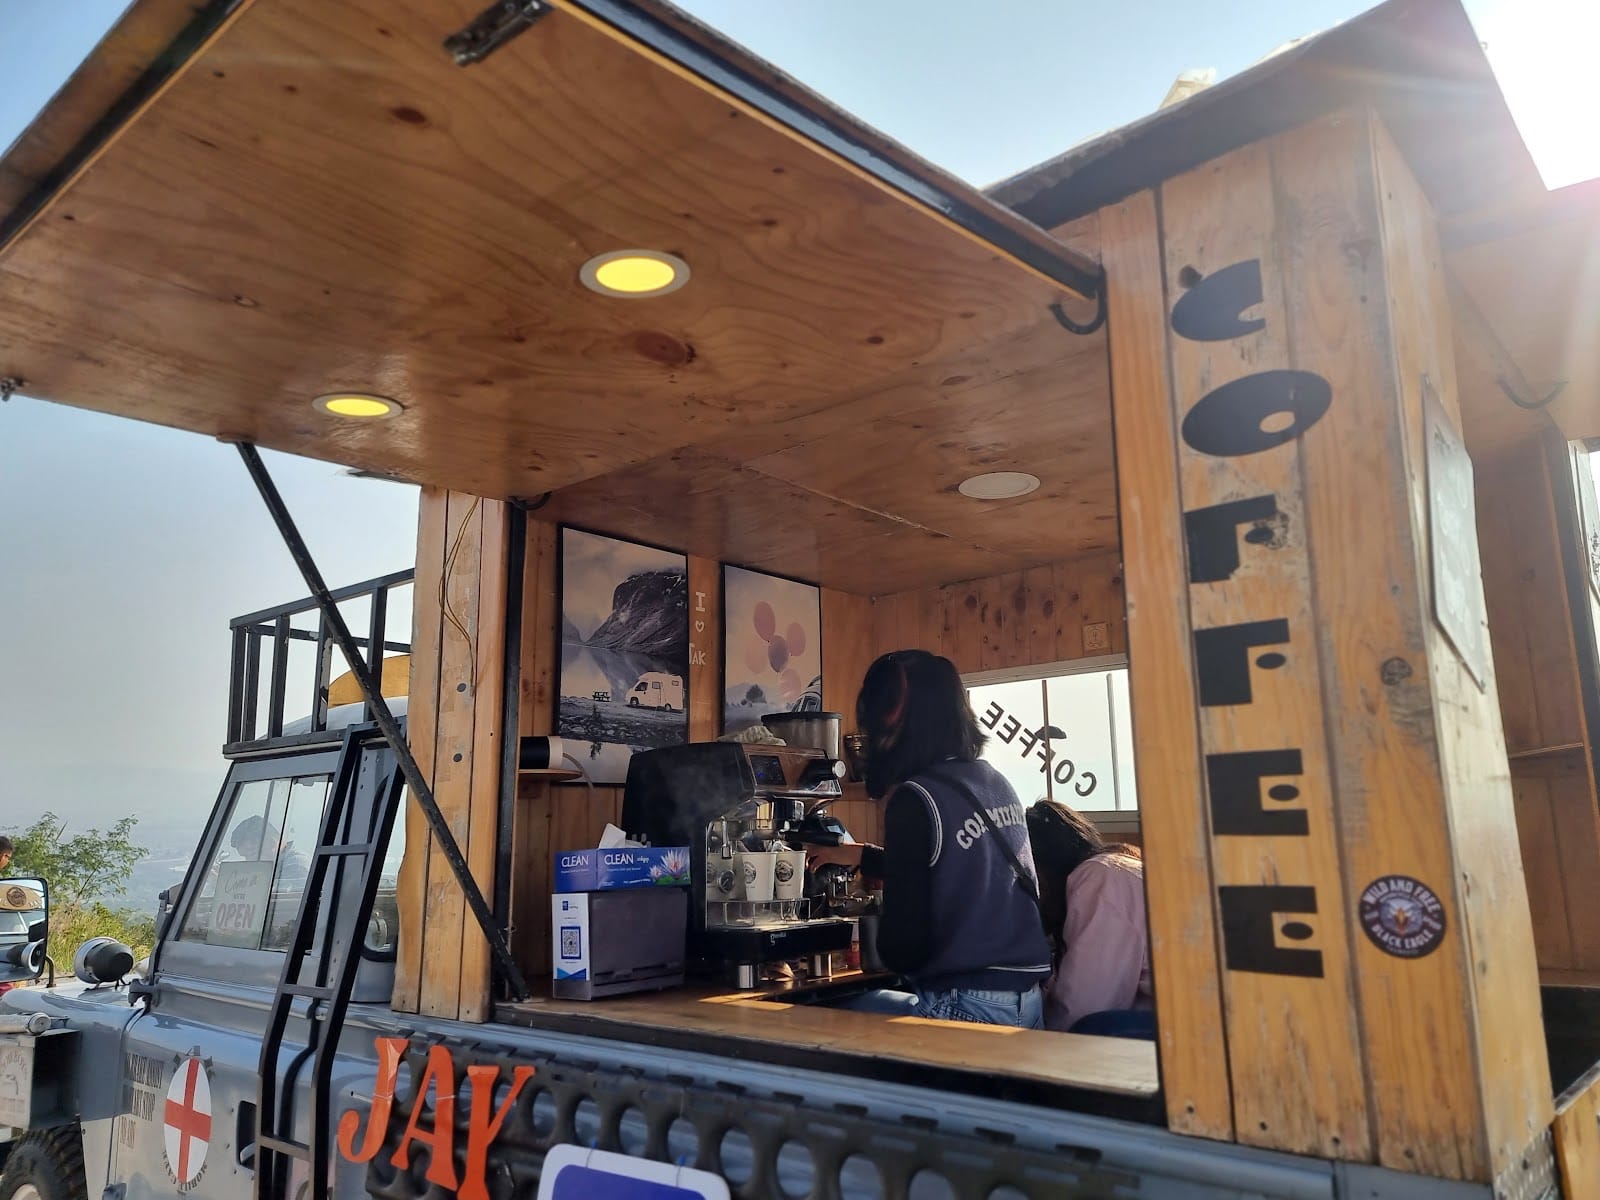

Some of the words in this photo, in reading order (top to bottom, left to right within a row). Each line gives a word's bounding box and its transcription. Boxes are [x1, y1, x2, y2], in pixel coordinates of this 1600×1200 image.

[695, 591, 706, 612] I
[1171, 258, 1332, 978] COFFEE
[561, 855, 589, 868] CLEAN
[604, 853, 634, 866] CLEAN
[1363, 881, 1390, 905] WILD
[1390, 879, 1413, 894] AND
[1413, 886, 1441, 913] FREE
[215, 902, 256, 929] OPEN
[1371, 923, 1402, 949] BLACK
[1404, 928, 1434, 950] EAGLE
[337, 1037, 536, 1200] JAY
